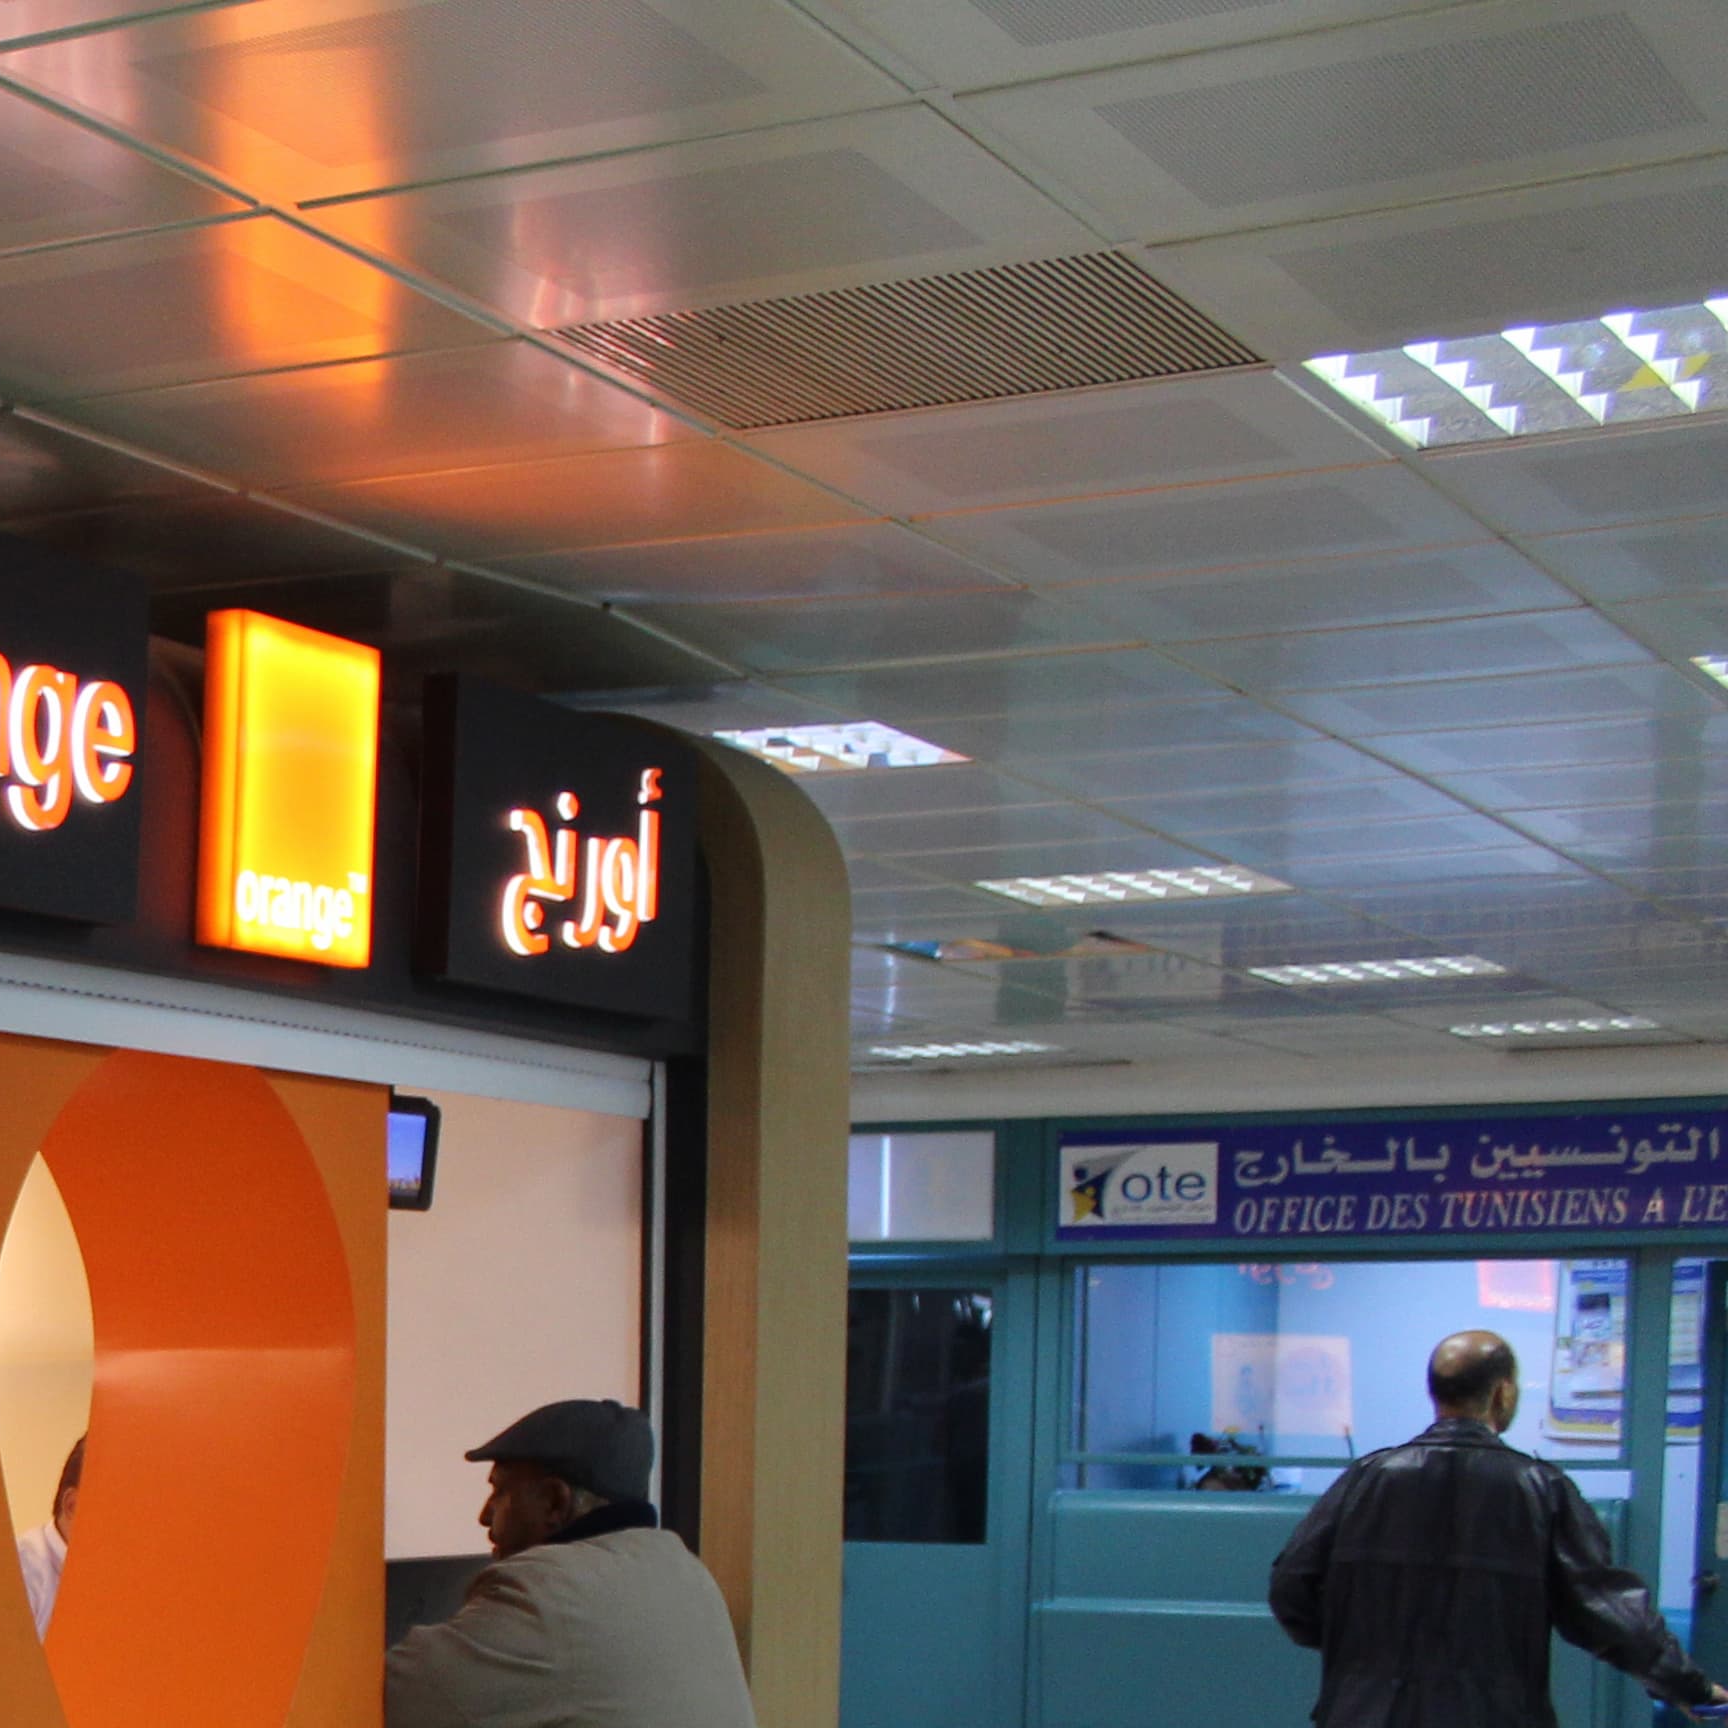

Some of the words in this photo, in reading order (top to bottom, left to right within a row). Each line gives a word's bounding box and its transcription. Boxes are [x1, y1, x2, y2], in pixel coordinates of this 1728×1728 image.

[501, 768, 663, 955] أورنج
[235, 870, 353, 951] orange
[1234, 1135, 1451, 1187] بالخارج
[1470, 1122, 1721, 1181] التونسيين
[1121, 1166, 1207, 1202] ote
[1234, 1195, 1357, 1234] OFFICE
[1365, 1193, 1430, 1230] DES
[1439, 1187, 1631, 1229] TUNISIENS
